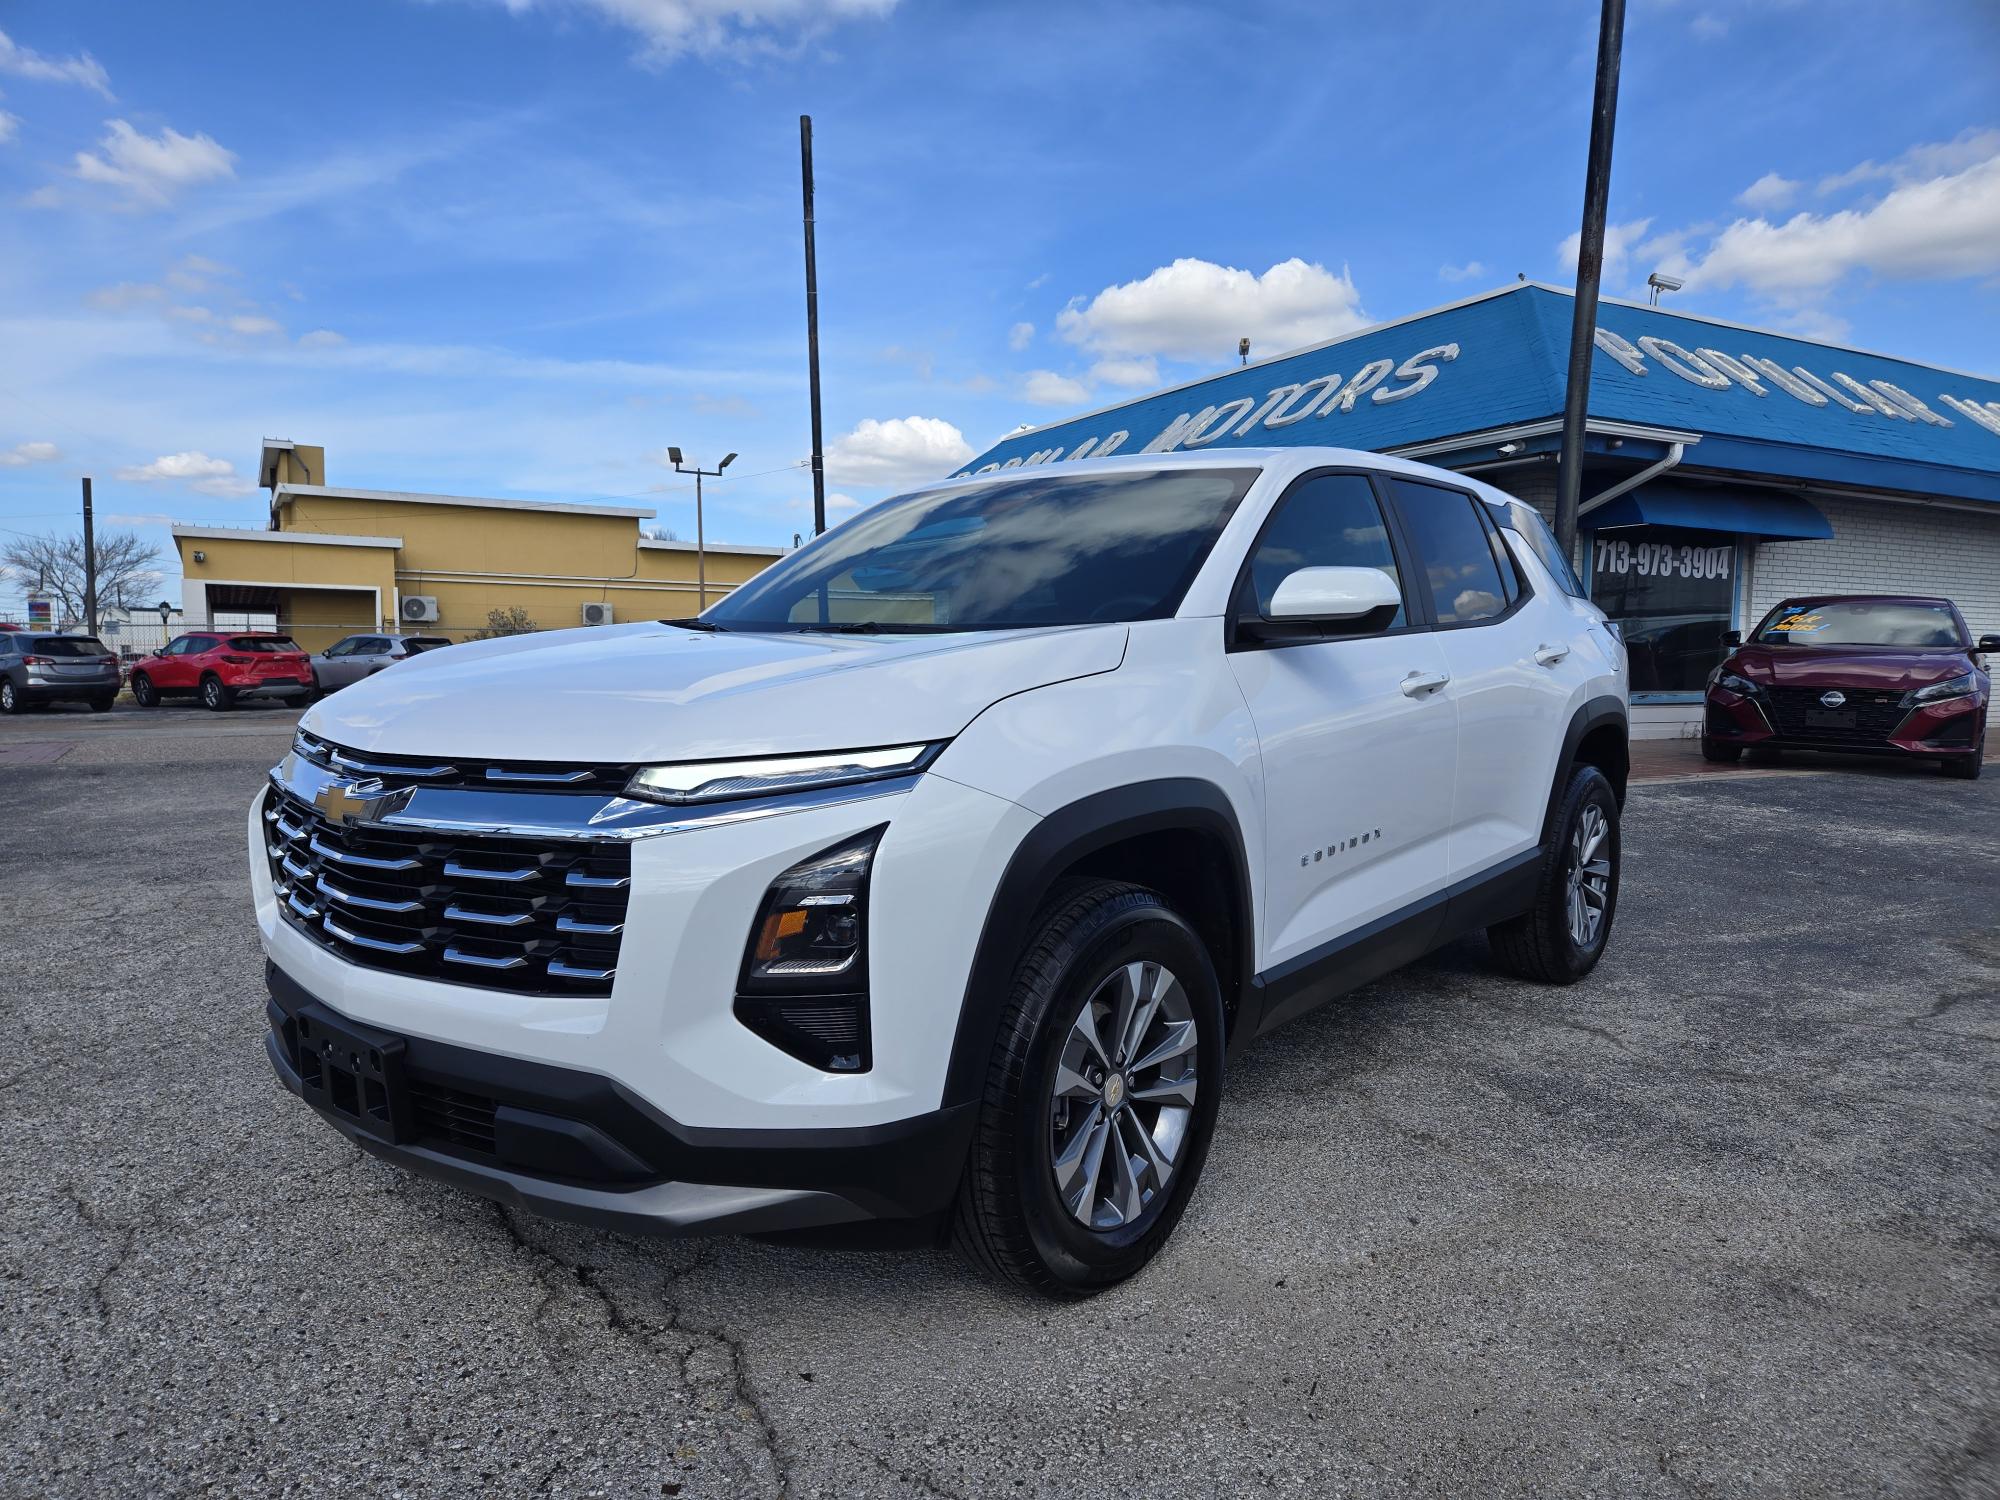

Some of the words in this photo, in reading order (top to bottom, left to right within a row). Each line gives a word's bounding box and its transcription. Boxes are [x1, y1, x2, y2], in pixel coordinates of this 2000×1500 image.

[1139, 343, 1460, 454] MOTORS
[1597, 539, 1729, 579] 713-973-3904
[1300, 828, 1382, 867] EQUINOX
